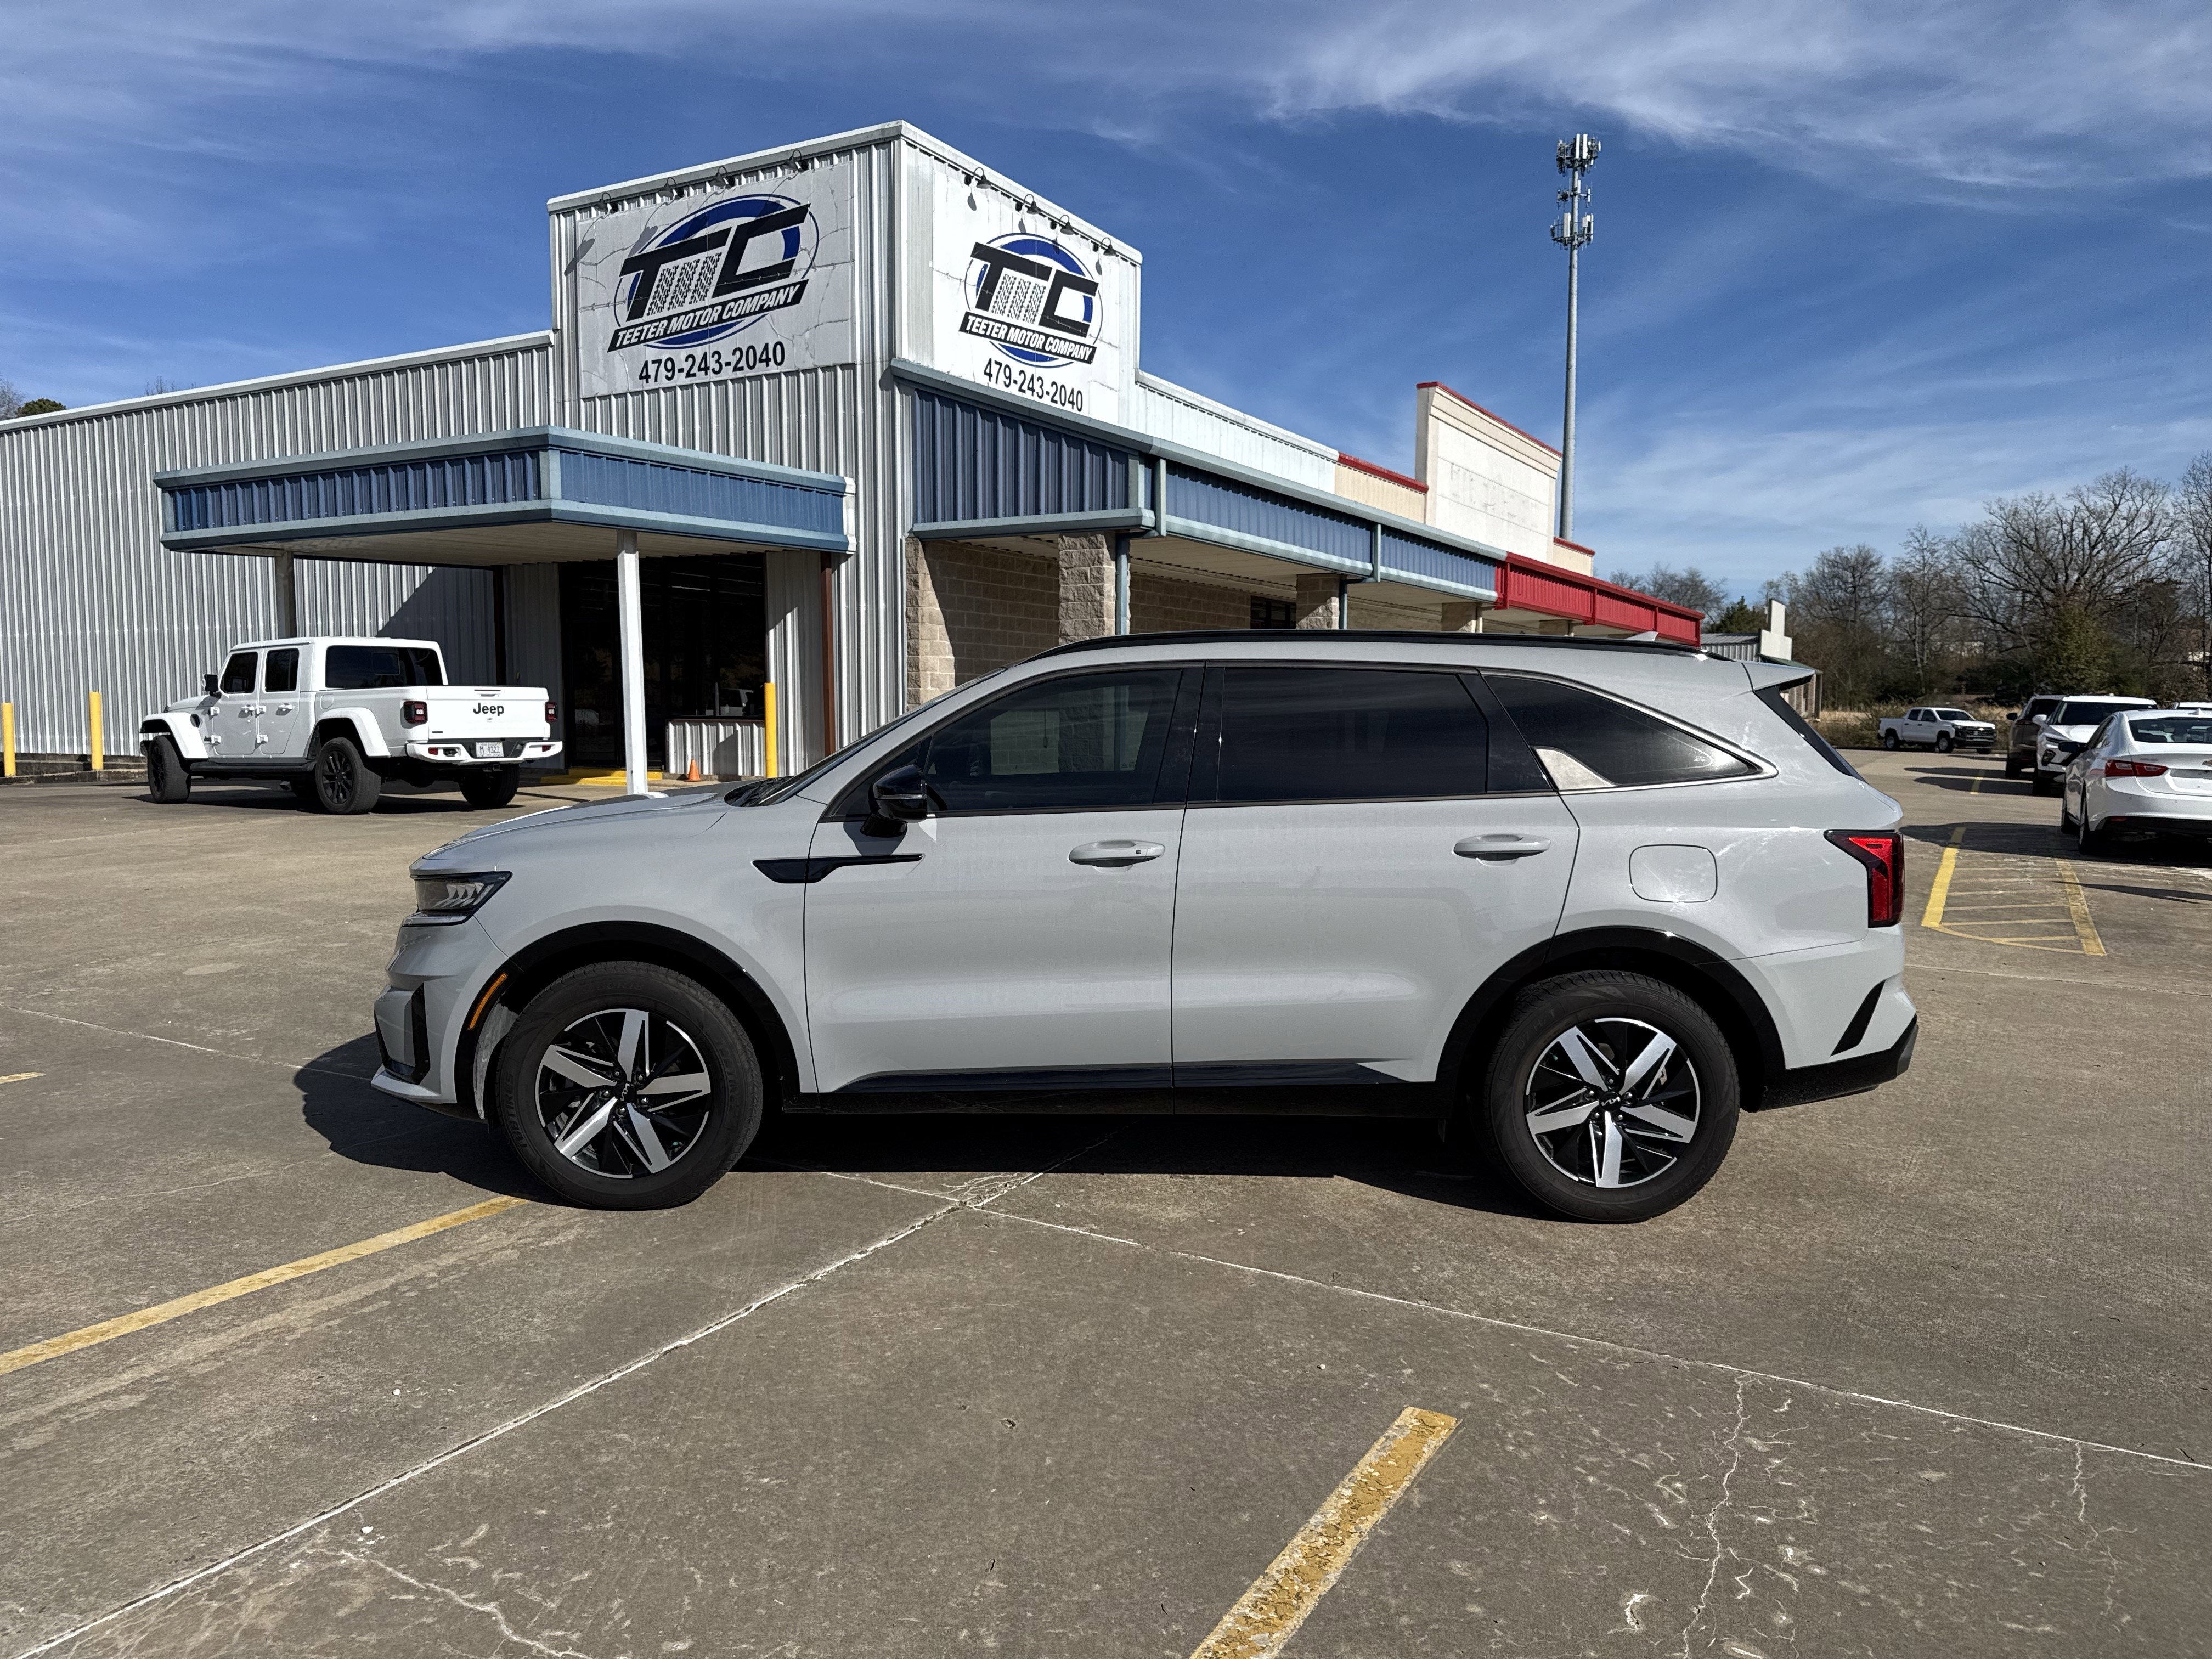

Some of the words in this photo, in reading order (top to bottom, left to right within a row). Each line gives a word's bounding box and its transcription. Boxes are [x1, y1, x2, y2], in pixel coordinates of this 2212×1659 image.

[616, 323, 665, 347] TEETER
[666, 308, 720, 334] MOTOR
[722, 284, 800, 319] COMPANY
[966, 315, 1008, 340] TEETER
[1006, 327, 1046, 349] MOTOR
[1045, 337, 1093, 360] COMPANY
[639, 341, 785, 383] 479-243-2040
[984, 358, 1083, 411] 479-243-2040
[473, 702, 504, 716] Jeep
